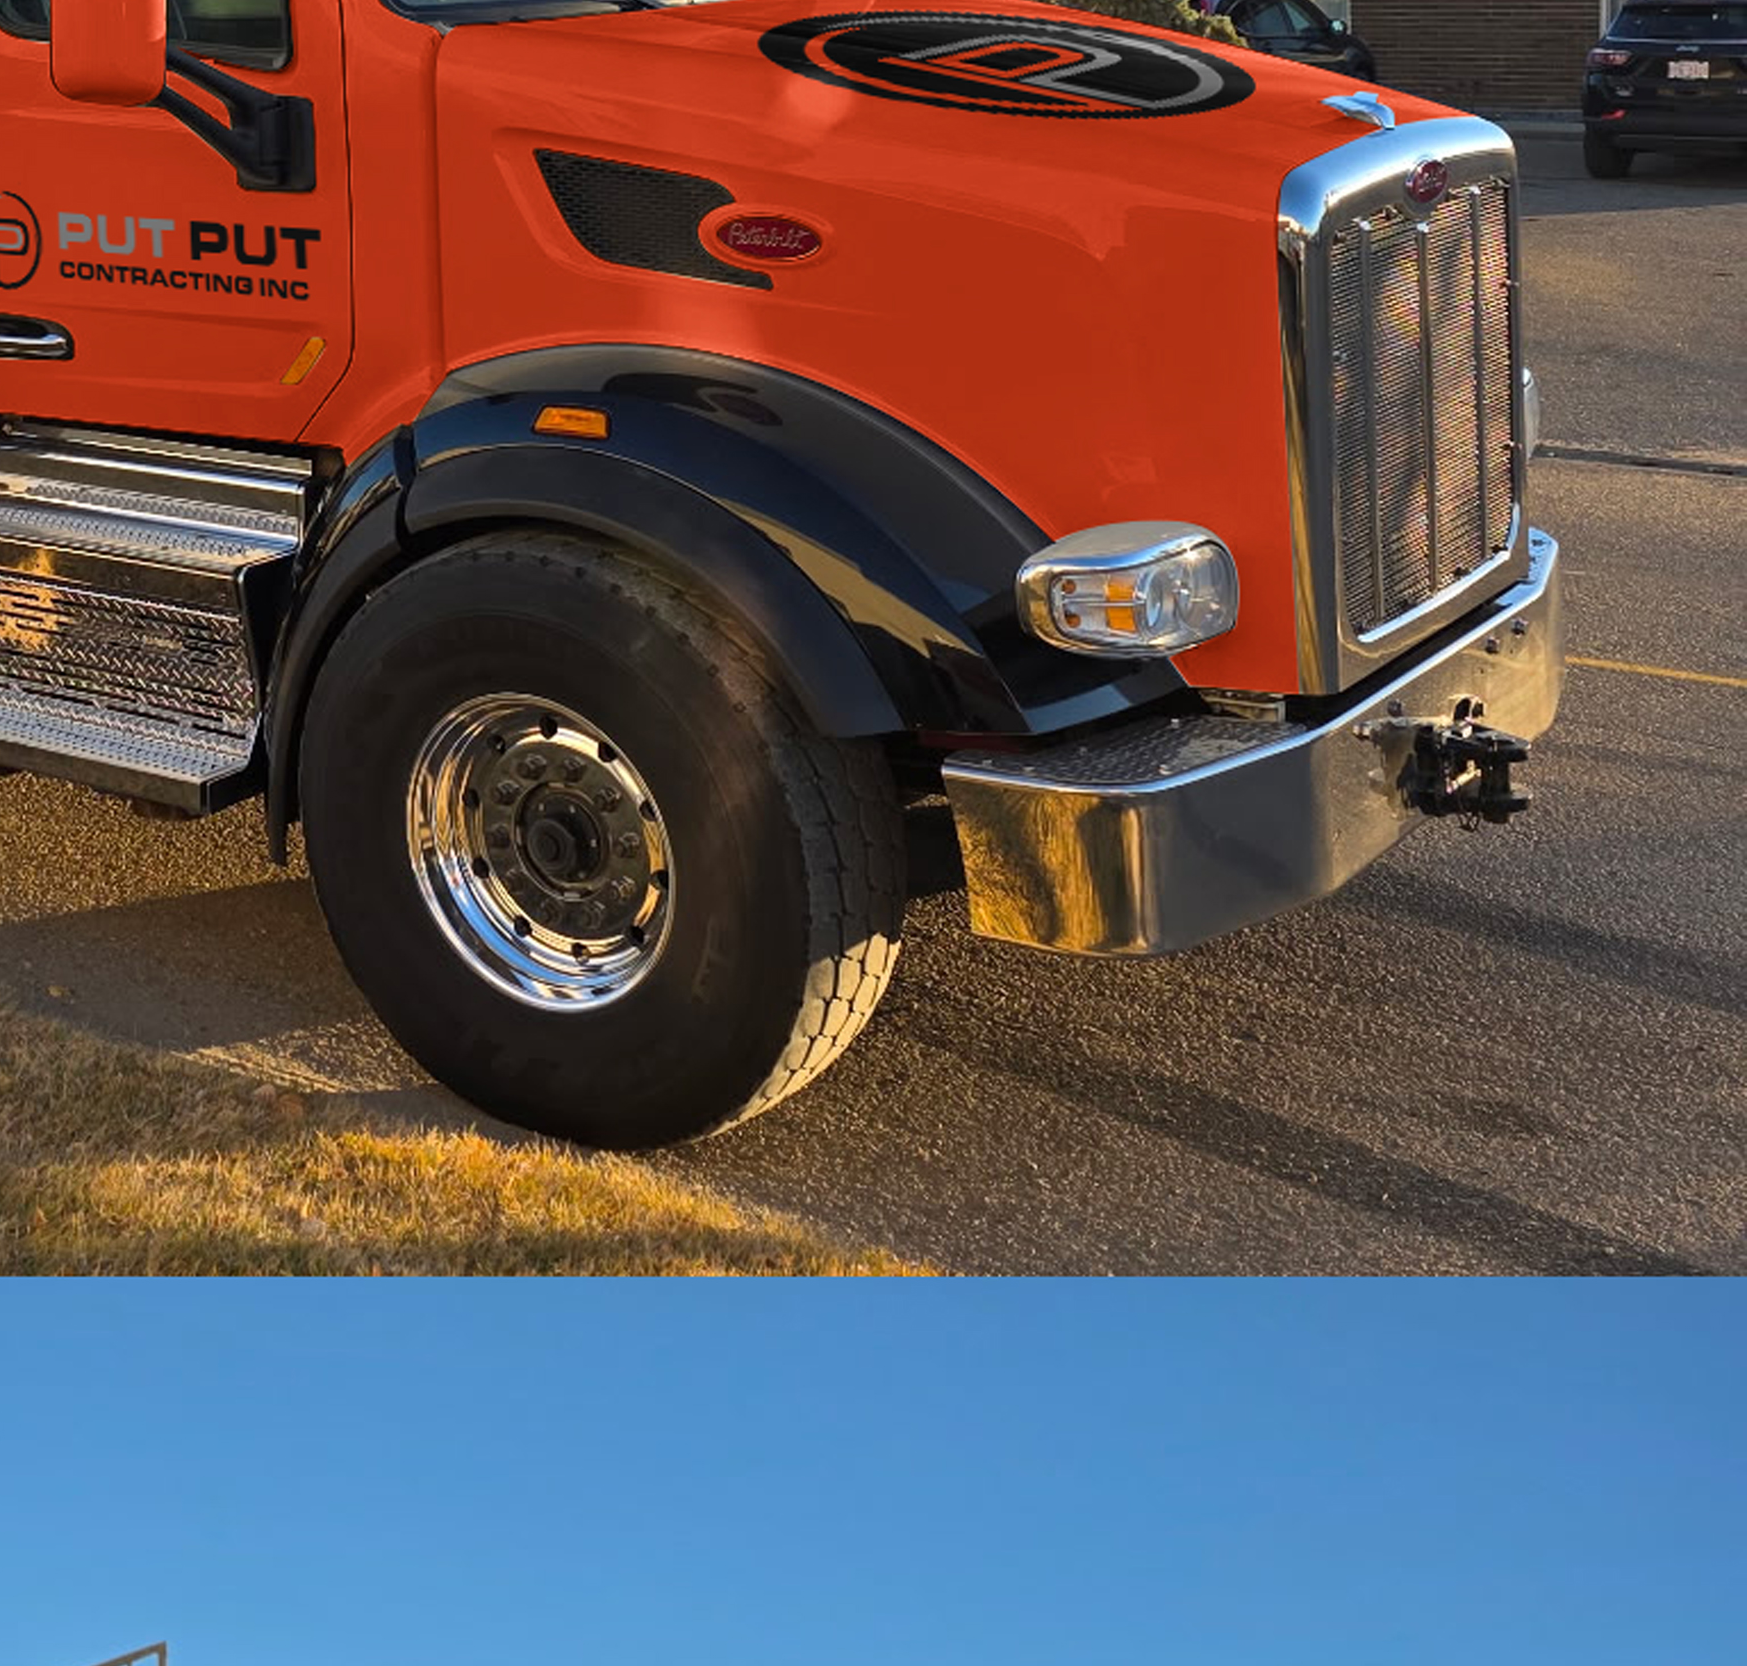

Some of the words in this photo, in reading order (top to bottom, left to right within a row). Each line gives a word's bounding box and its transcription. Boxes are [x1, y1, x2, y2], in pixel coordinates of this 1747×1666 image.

[58, 211, 175, 258] PUT
[189, 221, 321, 269] PUT
[59, 261, 253, 296] CONTRACTING
[259, 279, 310, 301] INC
